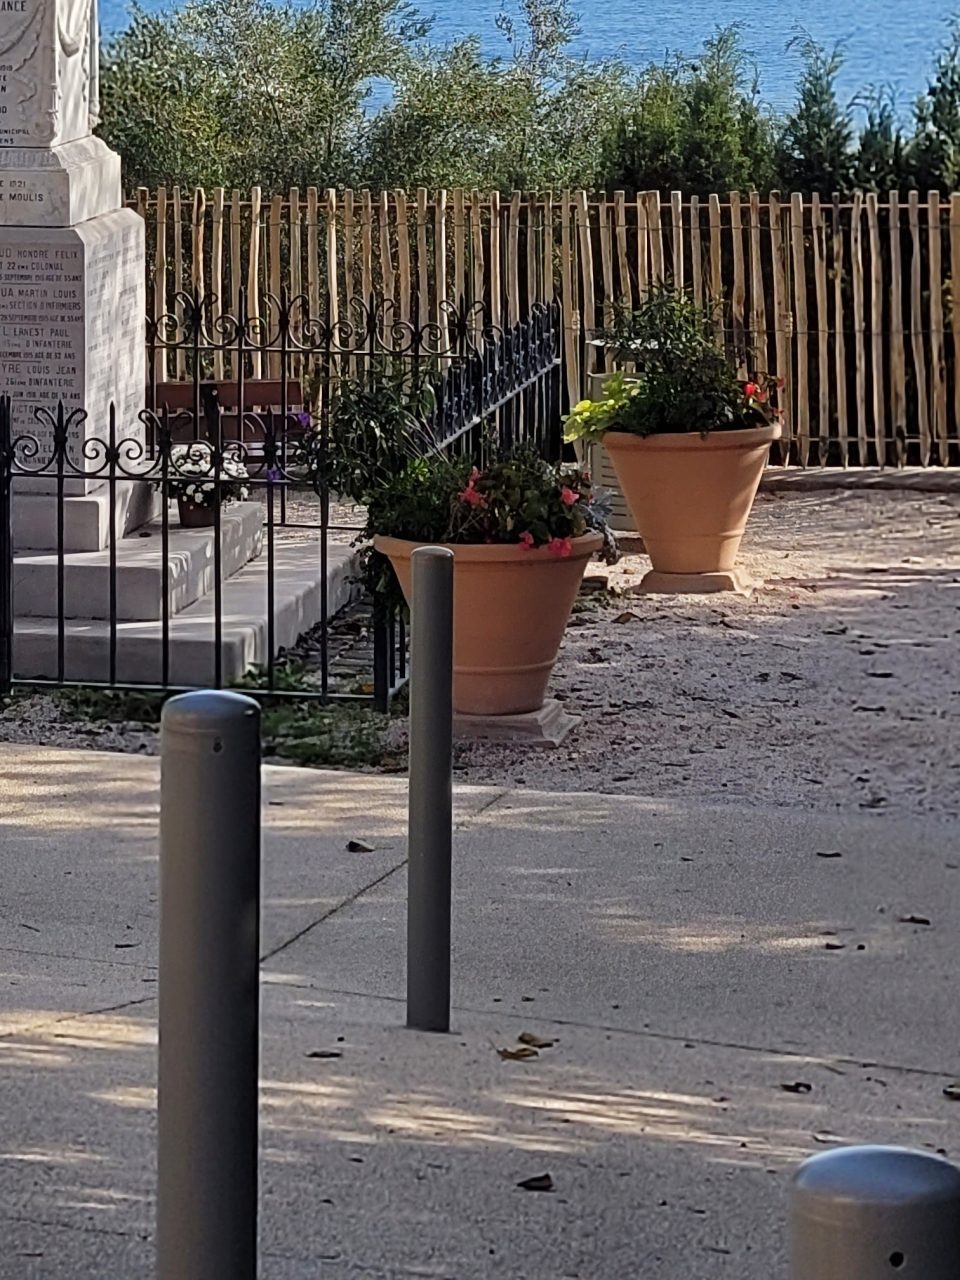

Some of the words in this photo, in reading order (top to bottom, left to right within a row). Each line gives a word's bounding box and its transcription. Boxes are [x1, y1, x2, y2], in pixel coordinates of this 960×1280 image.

[9, 193, 43, 202] MOULIS
[55, 250, 77, 259] FELIX
[31, 262, 64, 271] COLONIAL
[18, 289, 47, 297] MARTIN
[54, 290, 77, 298] LOUIS
[10, 301, 37, 309] SECTION
[14, 328, 44, 336] ERNEST
[50, 328, 69, 337] PAUL
[27, 366, 50, 374] LOUIS
[56, 366, 77, 374] JEAN
